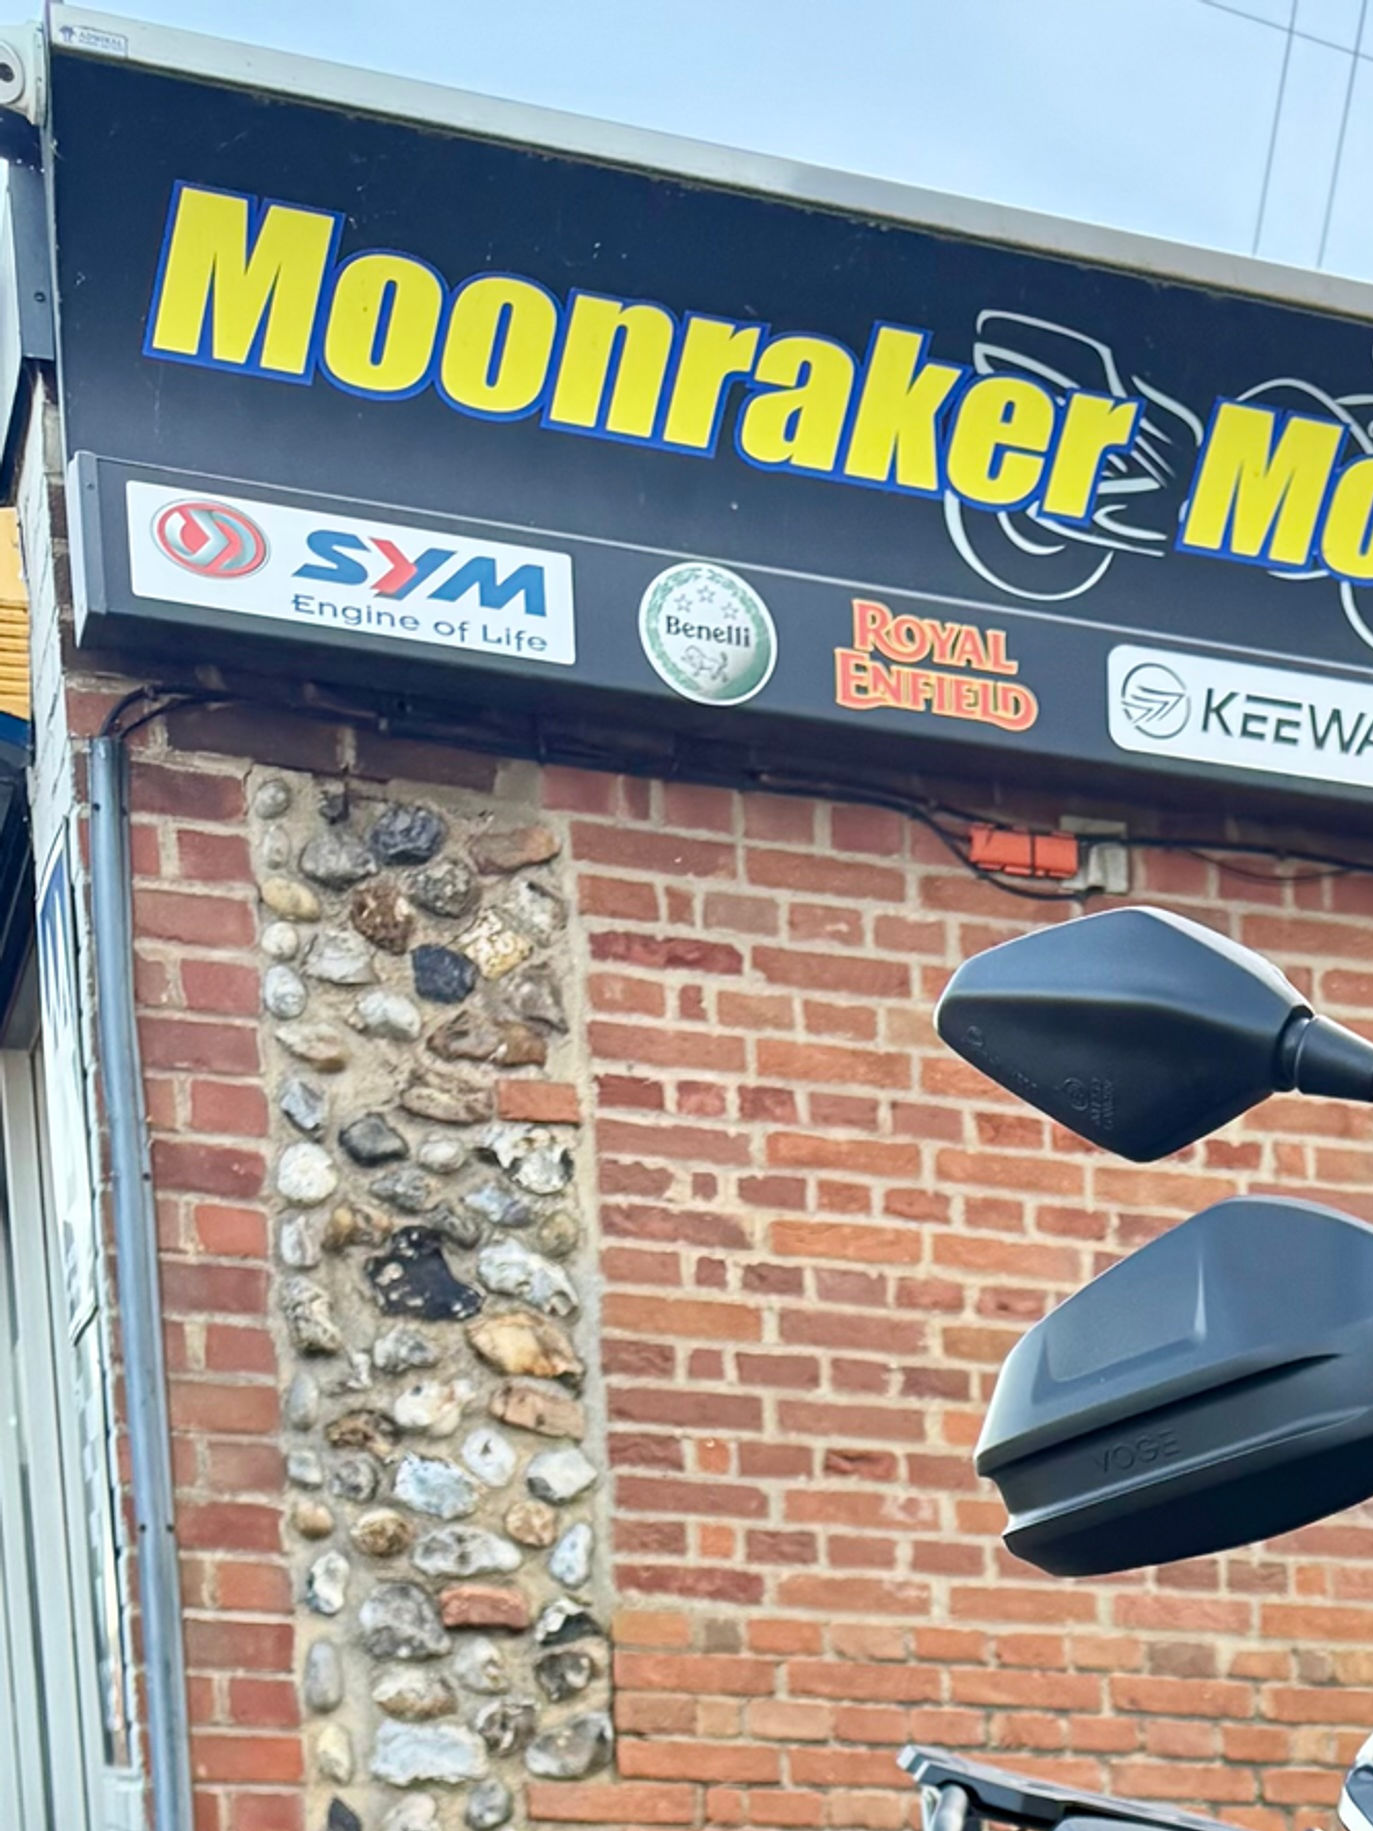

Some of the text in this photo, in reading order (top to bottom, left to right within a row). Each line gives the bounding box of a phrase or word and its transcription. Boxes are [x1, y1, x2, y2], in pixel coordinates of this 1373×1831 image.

[147, 182, 1145, 525] Moonraker
[291, 529, 547, 617] SYM
[291, 593, 548, 652] Engine of Life
[665, 614, 751, 648] Benelli
[852, 598, 1018, 676] ROYAL
[834, 647, 1039, 732] ENFIELD
[1091, 1429, 1182, 1474] VOGE
